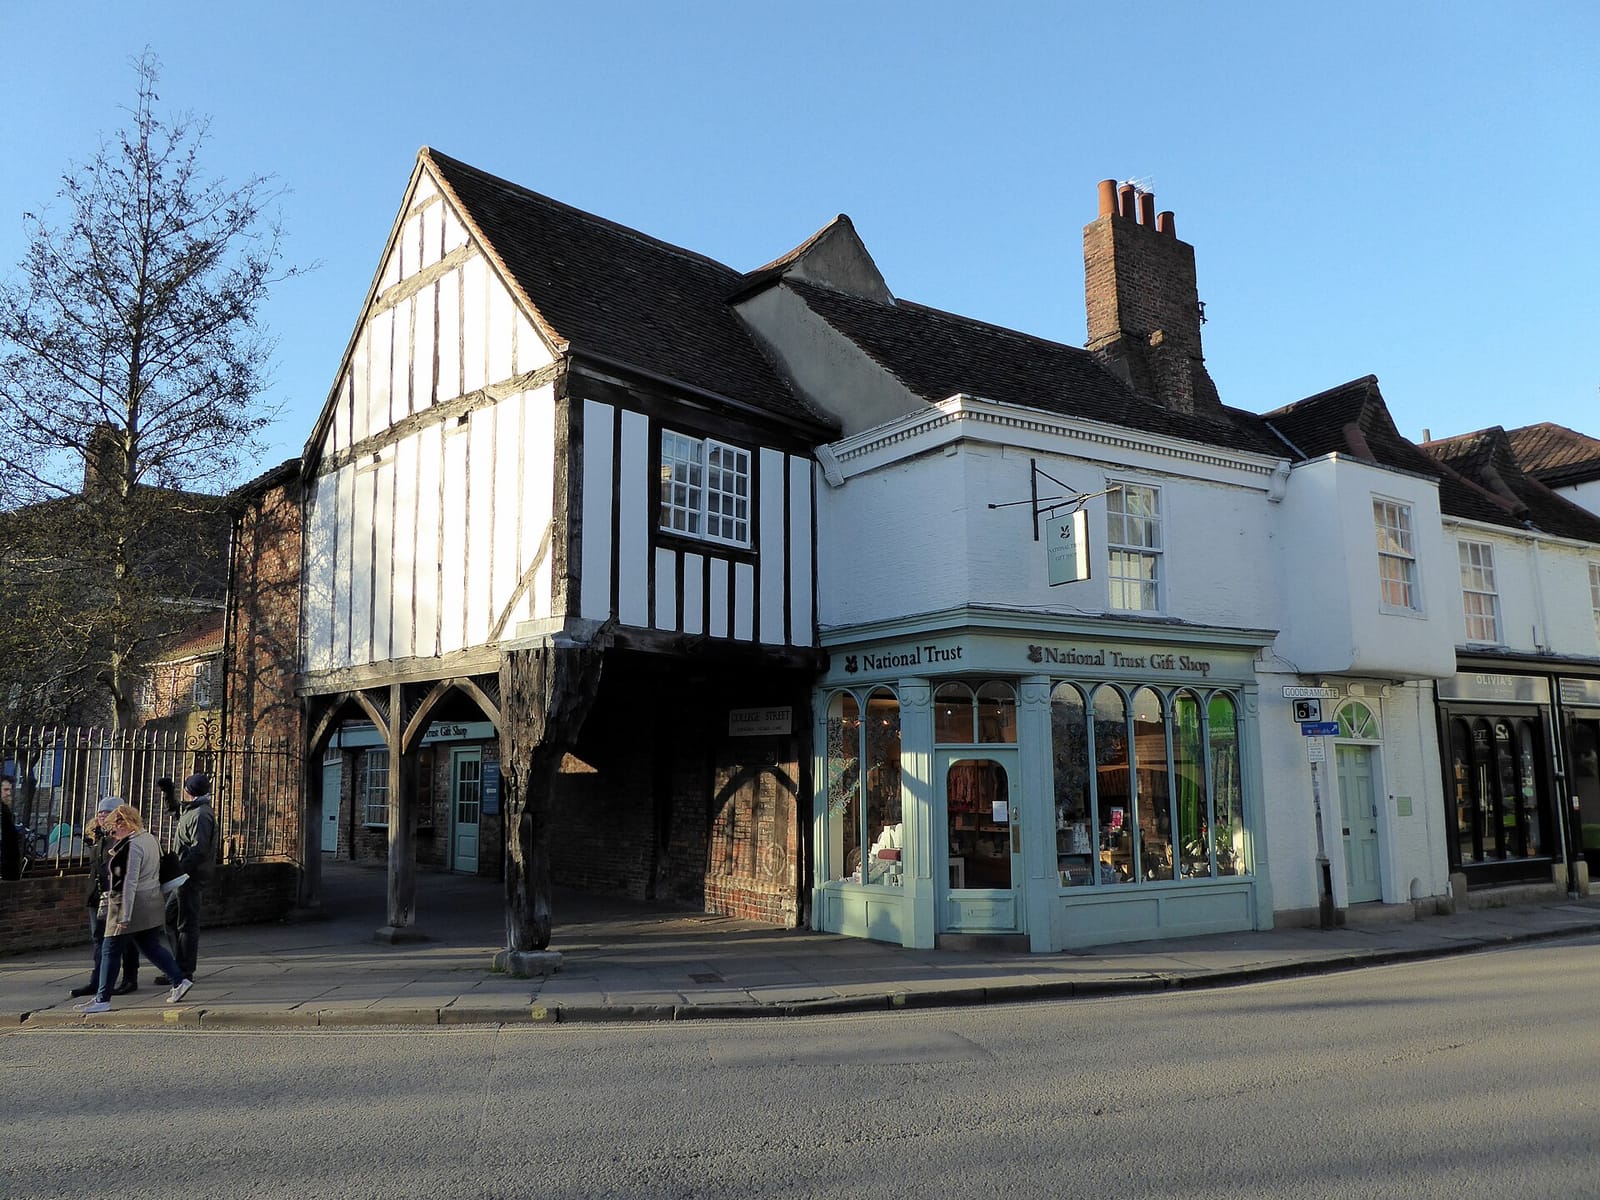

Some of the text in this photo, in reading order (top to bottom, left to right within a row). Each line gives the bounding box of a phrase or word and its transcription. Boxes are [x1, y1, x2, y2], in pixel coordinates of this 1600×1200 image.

[863, 645, 962, 671] National Trust
[1045, 648, 1211, 677] National Trust Gift Shop
[1476, 675, 1513, 687] OLIVIA'S
[1285, 687, 1338, 698] GOODRAMGATE
[731, 710, 791, 722] COLLEGE STREET
[440, 725, 452, 736] Gift
[453, 725, 468, 739] Shop
